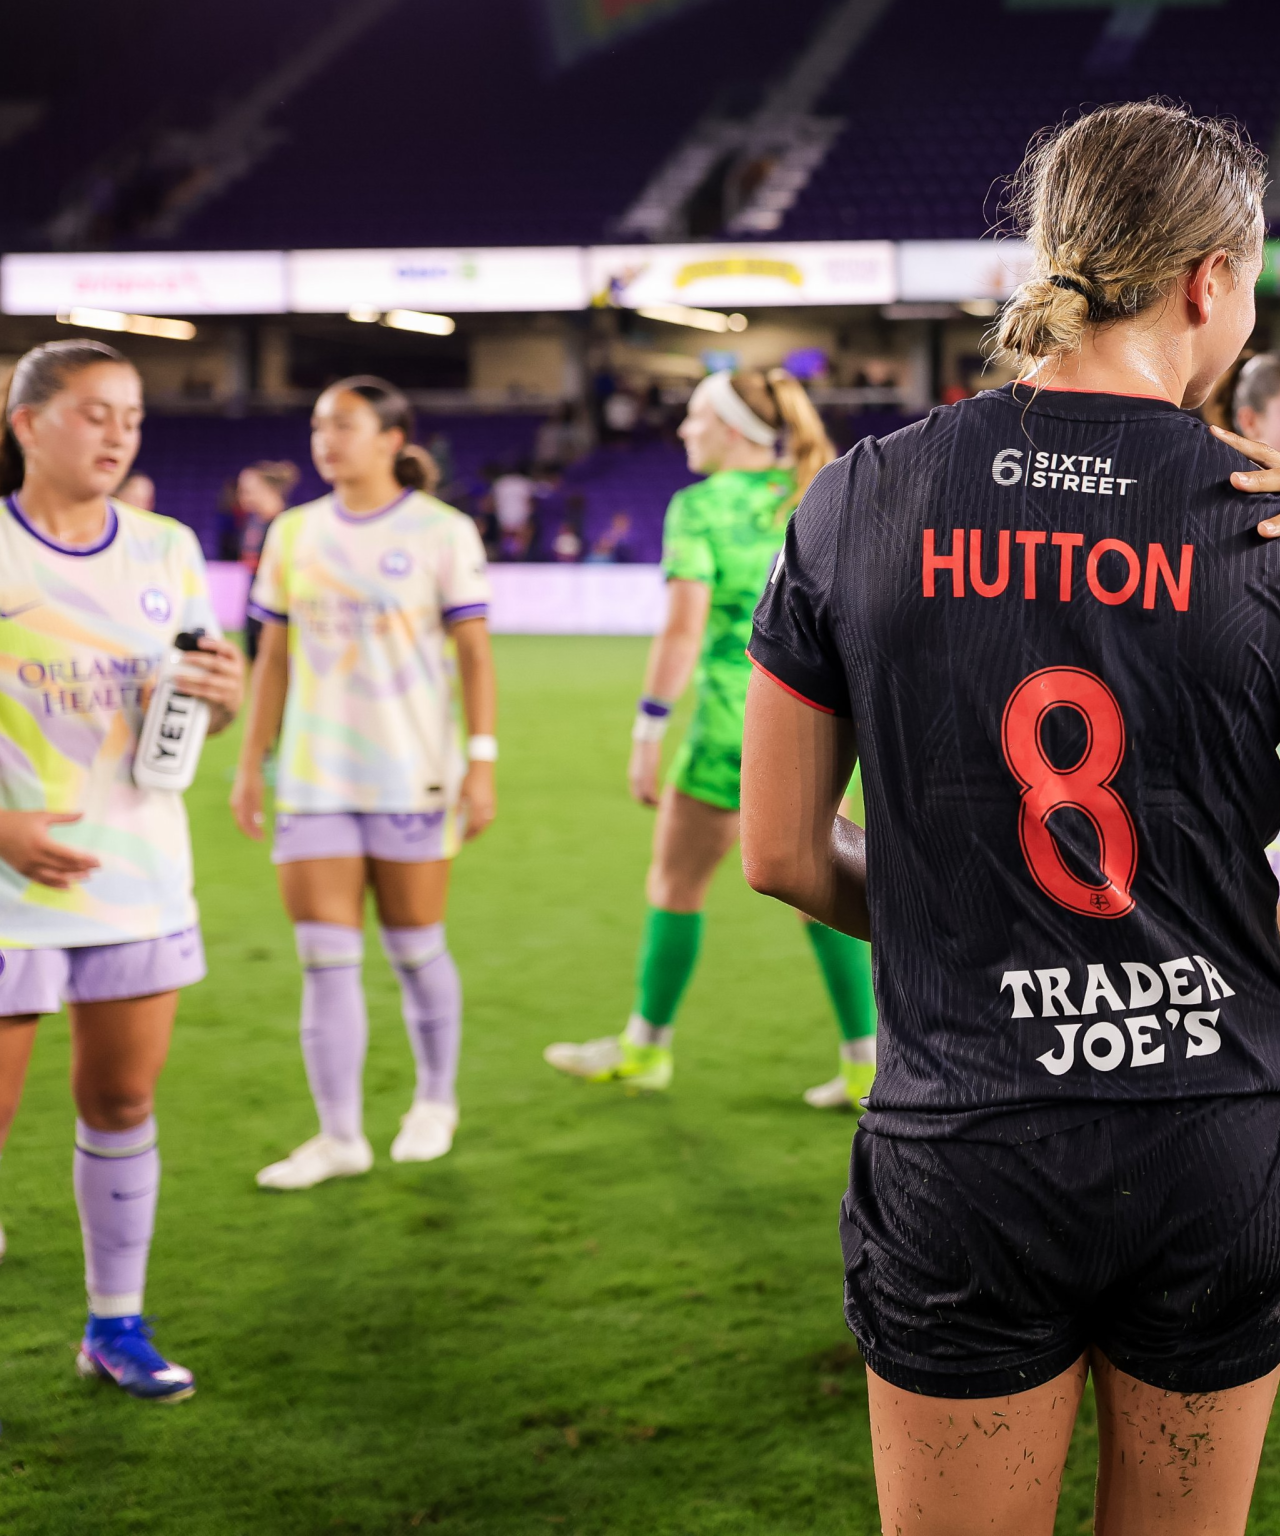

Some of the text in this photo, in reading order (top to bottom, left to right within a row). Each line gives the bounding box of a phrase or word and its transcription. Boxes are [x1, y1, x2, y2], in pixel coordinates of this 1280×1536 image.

[991, 447, 1024, 487] 6
[1034, 451, 1112, 475] SIXTH
[922, 527, 1193, 612] HUTTON
[17, 657, 161, 689] ORLAND
[152, 688, 192, 764] YETI
[1001, 665, 1139, 920] 8
[998, 954, 1237, 1020] TRADER
